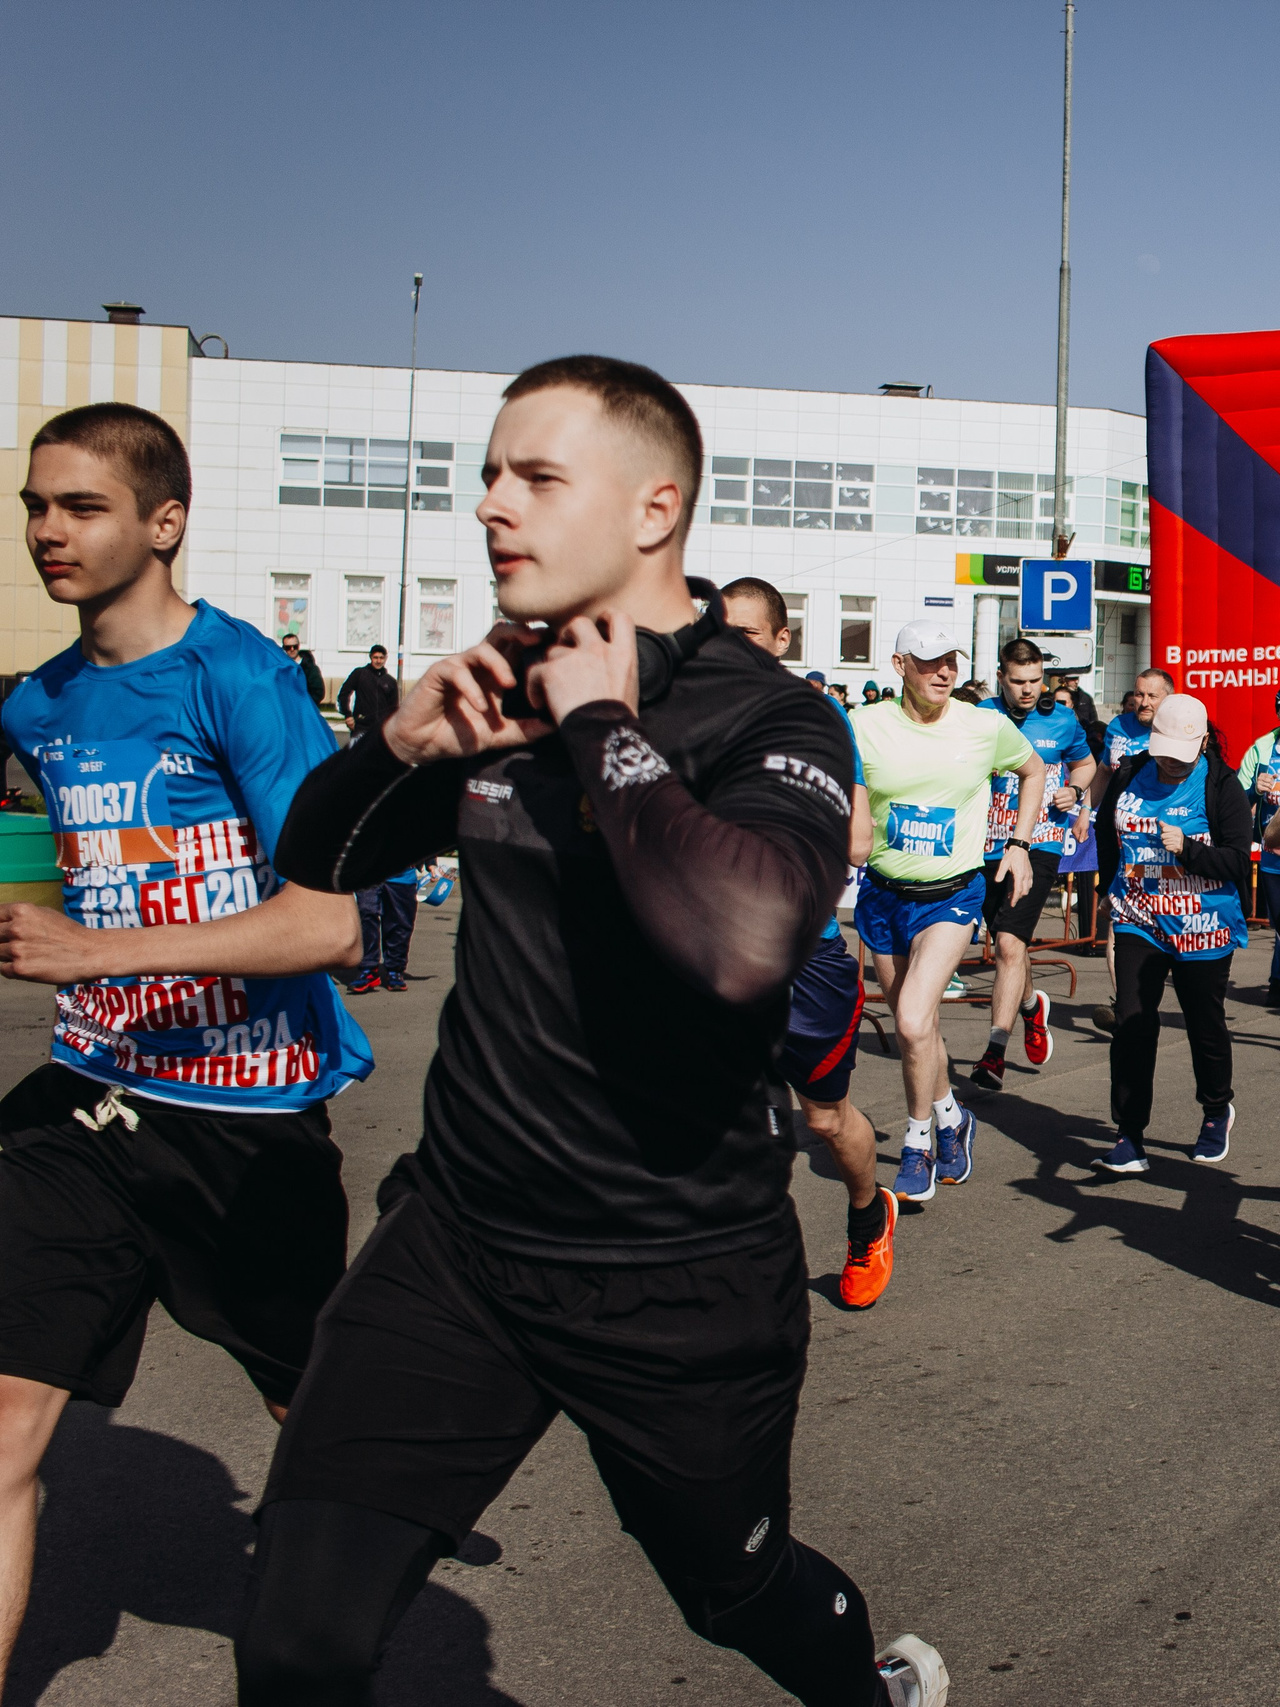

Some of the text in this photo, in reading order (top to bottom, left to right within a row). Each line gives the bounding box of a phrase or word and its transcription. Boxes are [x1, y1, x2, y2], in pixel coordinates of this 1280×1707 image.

[1043, 571, 1078, 621] P
[1166, 645, 1181, 664] В
[1186, 648, 1248, 666] ритме
[1186, 667, 1279, 689] СТРАНЫ!
[58, 781, 137, 827] 20037
[900, 819, 943, 841] 40001
[77, 829, 123, 868] 5KM
[1181, 911, 1220, 934] 2024
[203, 1010, 298, 1057] 2024
